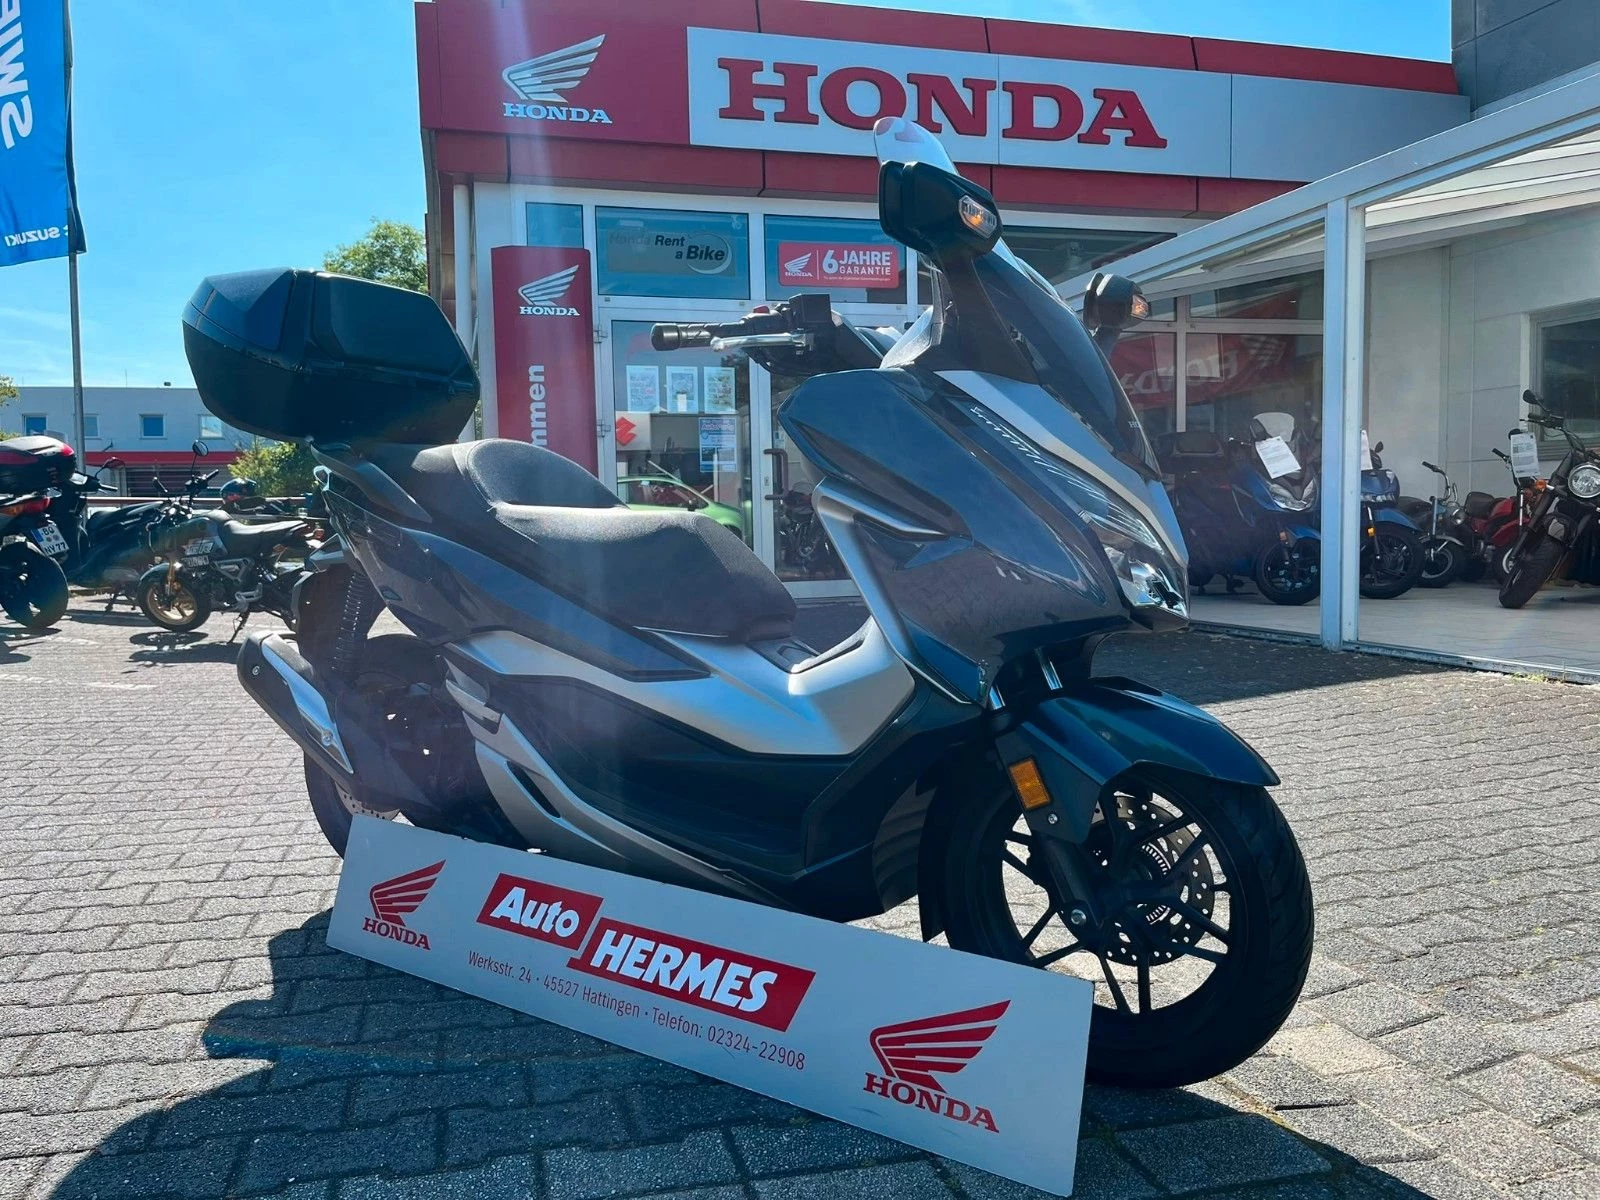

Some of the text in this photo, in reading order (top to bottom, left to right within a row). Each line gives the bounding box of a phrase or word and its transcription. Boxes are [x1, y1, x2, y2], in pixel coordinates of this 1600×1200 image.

[503, 102, 613, 124] HONDA
[717, 57, 1168, 148] HONDA
[655, 234, 686, 247] Rent
[675, 244, 726, 261] a Bike
[822, 249, 892, 275] 6 JAHRE
[839, 265, 892, 276] GARANTIE
[519, 305, 581, 317] HONDA
[490, 886, 580, 938] Auto
[362, 917, 431, 951] HONDA
[590, 929, 778, 1013] HERMES
[468, 950, 806, 1071] Werksstr. 24 45527 Hattingen Telefon: 02324-22908
[863, 1072, 1000, 1134] HONDA
